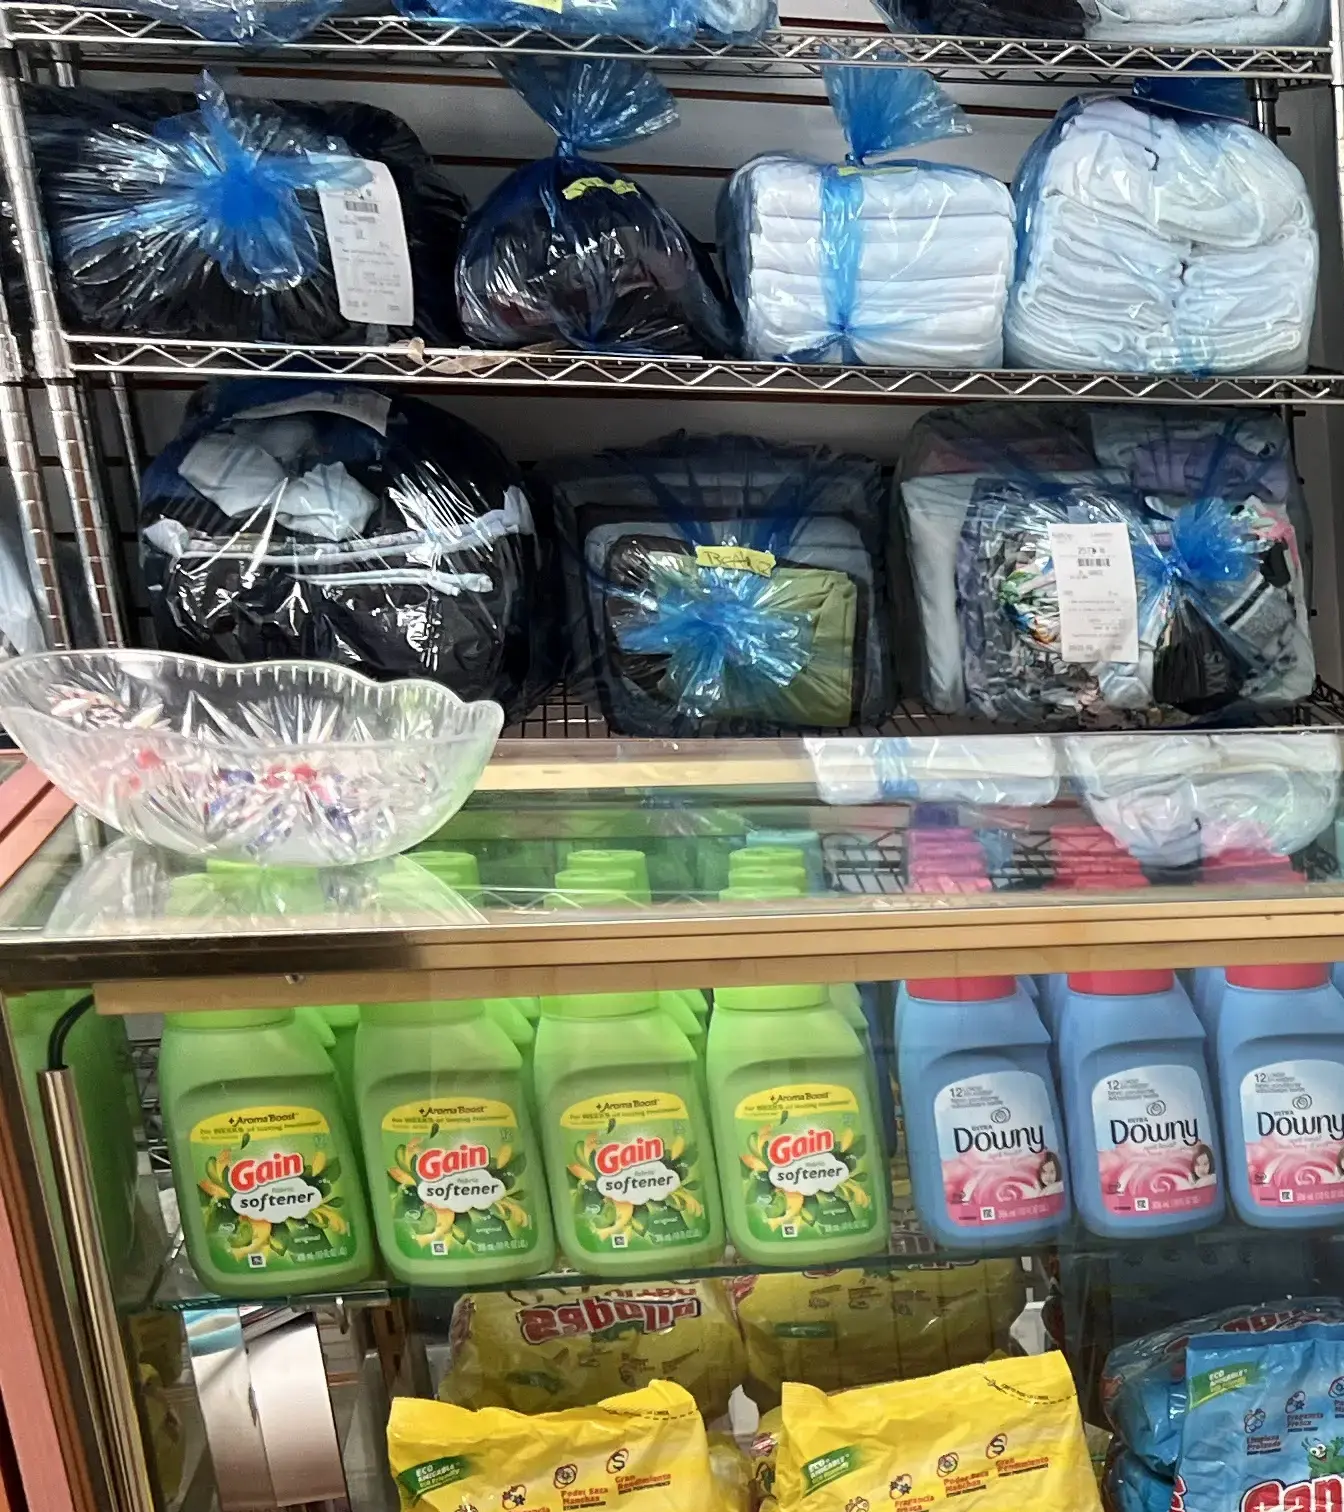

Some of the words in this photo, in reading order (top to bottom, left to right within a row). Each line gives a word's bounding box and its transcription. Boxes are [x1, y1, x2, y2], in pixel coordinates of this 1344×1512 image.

[1106, 1080, 1120, 1090] 12
[1254, 1073, 1267, 1083] 12
[949, 1088, 964, 1098] 12
[953, 1125, 1045, 1153] Downy
[1110, 1116, 1199, 1147] Downy
[596, 1136, 664, 1176] Gain
[768, 1127, 834, 1167] Gain
[230, 1152, 303, 1192] Gain
[416, 1144, 490, 1181] Gain
[605, 1174, 674, 1194] softener
[777, 1167, 843, 1186] softener
[426, 1183, 499, 1200] softener
[240, 1192, 314, 1212] softener
